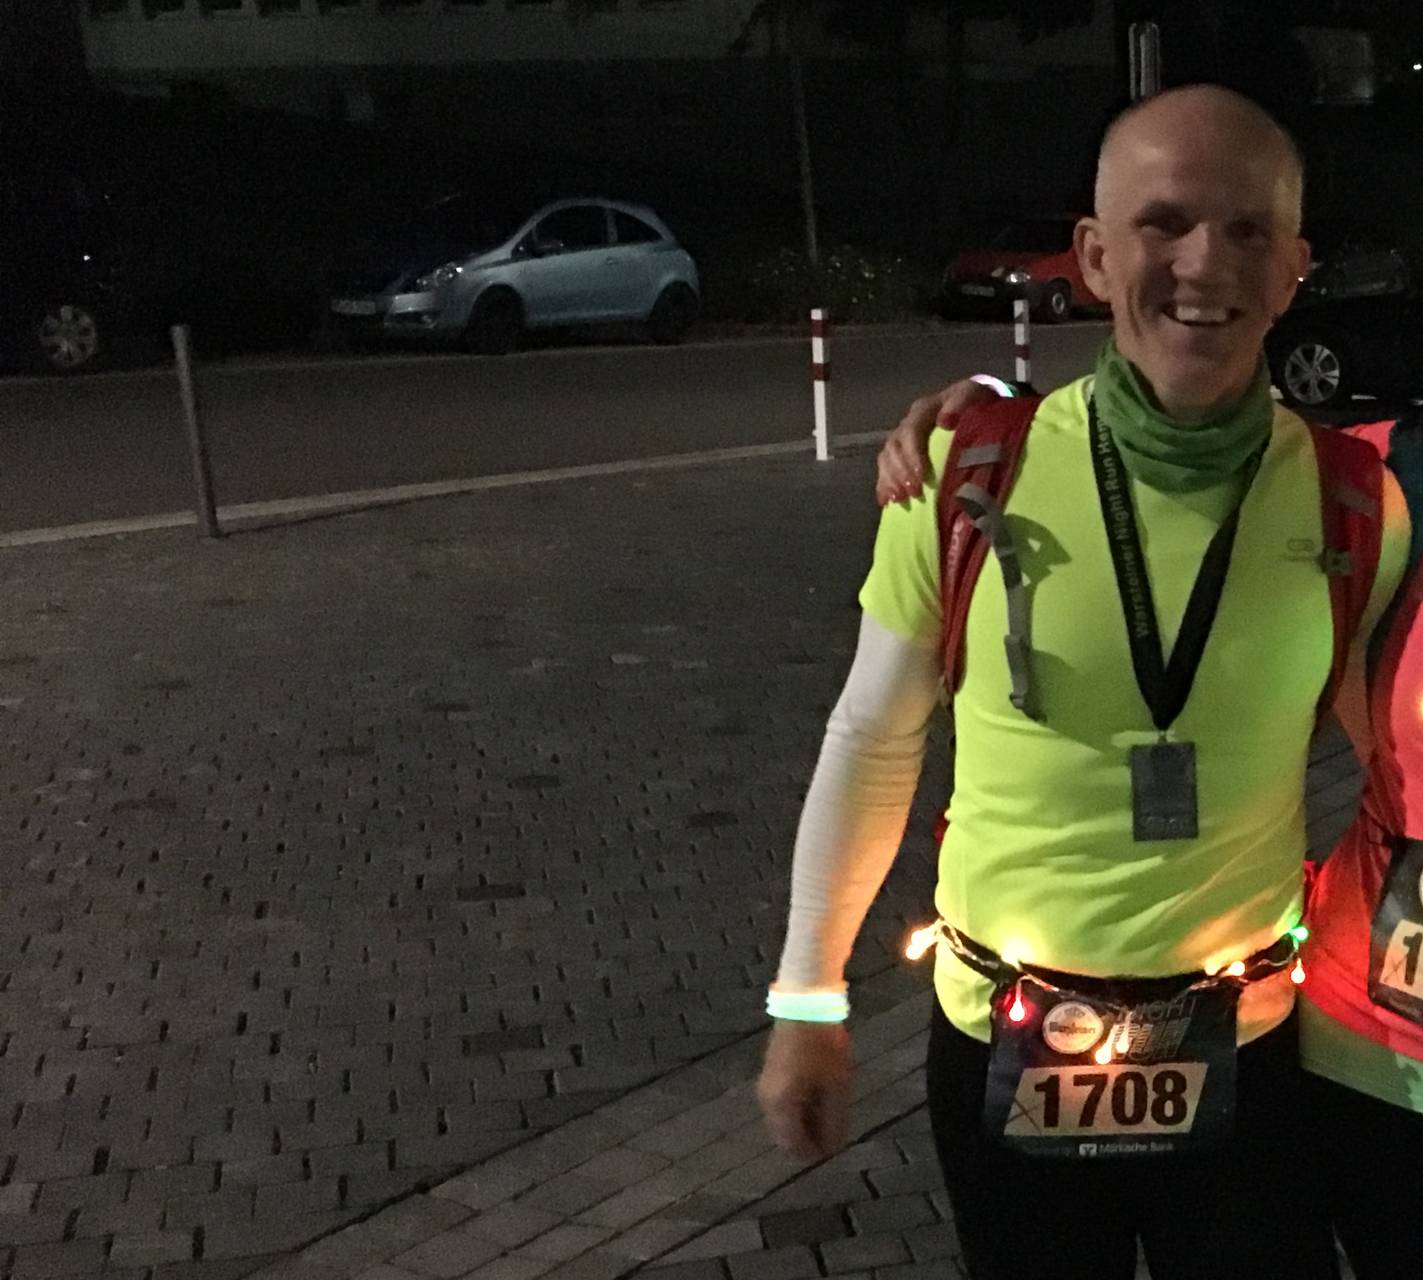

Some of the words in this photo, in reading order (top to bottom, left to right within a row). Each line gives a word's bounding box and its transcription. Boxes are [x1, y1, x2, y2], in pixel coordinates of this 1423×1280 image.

[1096, 418, 1112, 455] Hem
[1101, 456, 1121, 492] Run
[1107, 493, 1131, 541] Night
[1034, 1069, 1188, 1128] 1708
